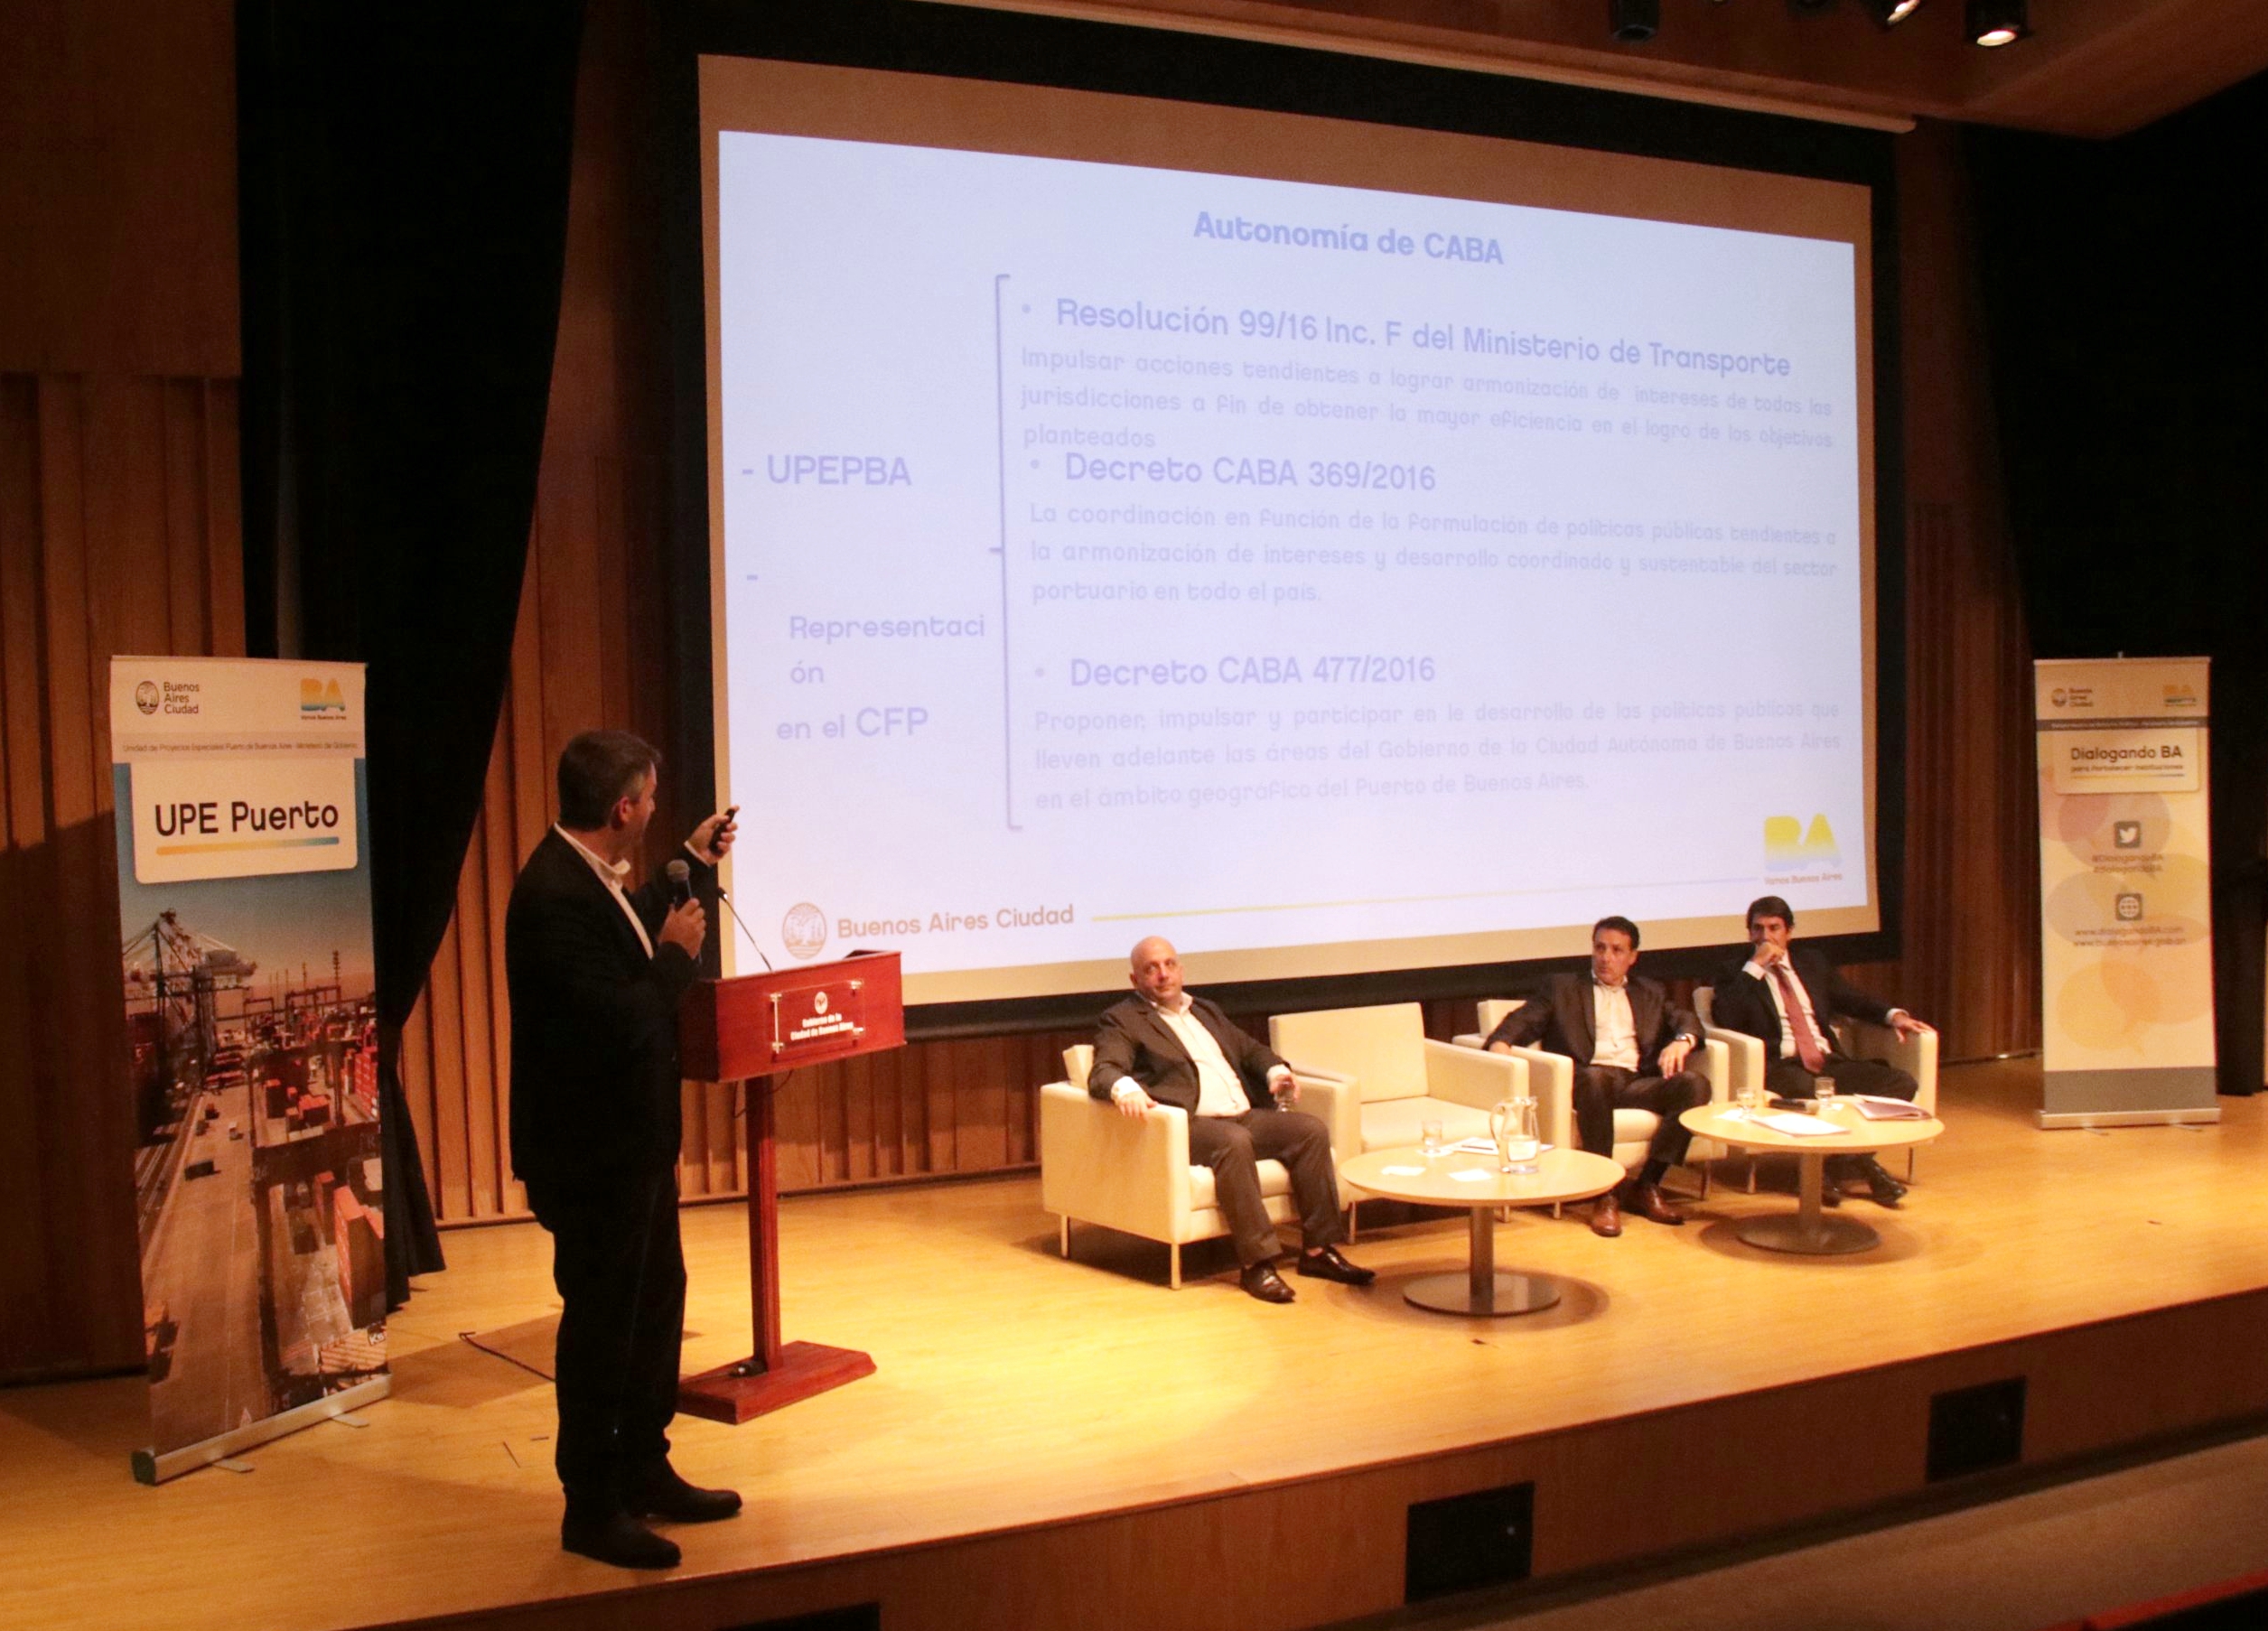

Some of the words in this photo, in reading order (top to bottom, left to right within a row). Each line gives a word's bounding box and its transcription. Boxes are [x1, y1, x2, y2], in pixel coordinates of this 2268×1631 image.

[1194, 211, 1368, 251] Autonomía
[1377, 228, 1414, 256] de
[1424, 232, 1504, 265] CABA
[1057, 298, 1228, 335] Resolución
[1239, 310, 1318, 340] 99/16
[1326, 316, 1375, 345] Inc.
[1386, 321, 1402, 346] F
[1413, 323, 1453, 350] del
[1464, 327, 1600, 361] Ministerio
[1610, 339, 1640, 364] de
[1648, 341, 1790, 378] Transporte
[1022, 346, 1125, 374] Impulsar
[1135, 355, 1233, 377] acciones
[1243, 360, 1359, 384] tendientes
[1368, 371, 1381, 385] a
[1390, 368, 1454, 394] lograr
[1462, 377, 1589, 399] armonización
[1597, 381, 1619, 401] de
[1635, 386, 1719, 407] intereses
[1726, 392, 1747, 409] de
[1754, 396, 1802, 414] todas
[1809, 398, 1832, 416] las
[1021, 386, 1181, 411] jurisdicciones
[1192, 396, 1205, 412] a
[1217, 394, 1246, 414] fin
[1258, 396, 1284, 416] de
[1293, 398, 1379, 420] obtener
[1388, 403, 1406, 422] la
[1417, 409, 1480, 431] mayor
[1489, 409, 1582, 432] eficiencia
[1591, 420, 1612, 433] en
[1621, 418, 1638, 435] el
[1645, 419, 1691, 443] logro
[1699, 422, 1721, 440] de
[1759, 426, 1834, 449] objetivos
[1023, 424, 1156, 449] planteados
[768, 454, 911, 485] UPEPBA
[1066, 452, 1202, 482] Decreto
[1213, 456, 1298, 486] CABA
[1309, 461, 1435, 490] 369/2016
[1031, 503, 1057, 523] La
[1067, 503, 1215, 526] coordinación
[1225, 511, 1250, 527] en
[1259, 508, 1339, 529] función
[1349, 510, 1374, 529] de
[1382, 511, 1400, 530] la
[1408, 512, 1527, 534] formulación
[1535, 516, 1560, 536] de
[1731, 525, 1820, 545] tendientes
[1031, 540, 1050, 561] la
[1062, 542, 1217, 564] armonización
[1227, 543, 1254, 564] de
[1264, 545, 1366, 564] intereses
[1375, 551, 1386, 572] y
[1395, 546, 1498, 567] desarrollo
[1507, 550, 1613, 571] coordinado
[1619, 557, 1630, 577] y
[1638, 555, 1745, 573] sustentable
[1751, 557, 1778, 574] del
[1783, 561, 1837, 576] sector
[1032, 581, 1148, 605] portuario
[1153, 585, 1180, 601] en
[1187, 581, 1241, 601] todo
[1247, 581, 1266, 601] el
[790, 614, 985, 645] Representaci
[163, 682, 200, 693] Buenos
[790, 660, 824, 685] ón
[1070, 658, 1208, 686] Decreto
[1218, 656, 1302, 684] CABA
[1312, 655, 1435, 683] 477/2016
[163, 694, 190, 704] Aires
[164, 704, 200, 714] Ciudad
[776, 722, 811, 740] en
[822, 713, 845, 739] el
[856, 706, 929, 737] CFP
[1158, 707, 1257, 732] impulsar
[1268, 711, 1282, 732] y
[1293, 704, 1403, 730] participar
[1413, 708, 1437, 722] en
[1475, 702, 1573, 722] desarrollo
[1582, 701, 1605, 720] de
[1616, 702, 1641, 720] las
[1811, 704, 1839, 722] que
[1035, 749, 1101, 770] lleven
[1112, 745, 1216, 768] adelante
[1226, 743, 1256, 763] las
[1265, 742, 1329, 762] áreas
[1338, 740, 1369, 760] del
[1378, 738, 1470, 759] Gobierno
[1479, 737, 1502, 756] de
[1510, 737, 1528, 755] la
[1535, 734, 1600, 755] Ciudad
[1607, 735, 1698, 753] Autónoma
[1705, 732, 1726, 751] de
[1733, 732, 1794, 751] Buenos
[1801, 732, 1840, 750] Aires
[2070, 746, 2157, 763] Dialogando
[2161, 745, 2182, 759] BA
[1035, 793, 1063, 809] en
[1069, 788, 1091, 808] el
[1097, 785, 1182, 807] ámbito
[1188, 779, 1311, 810] geográfico
[1316, 778, 1349, 798] del
[1356, 777, 1426, 797] Puerto
[1433, 774, 1456, 794] de
[1464, 773, 1533, 793] Buenos
[154, 802, 219, 836] UPE
[231, 800, 339, 833] Puerto
[836, 918, 921, 939] Buenos
[929, 912, 988, 934] Aires
[996, 904, 1075, 929] Ciudad
